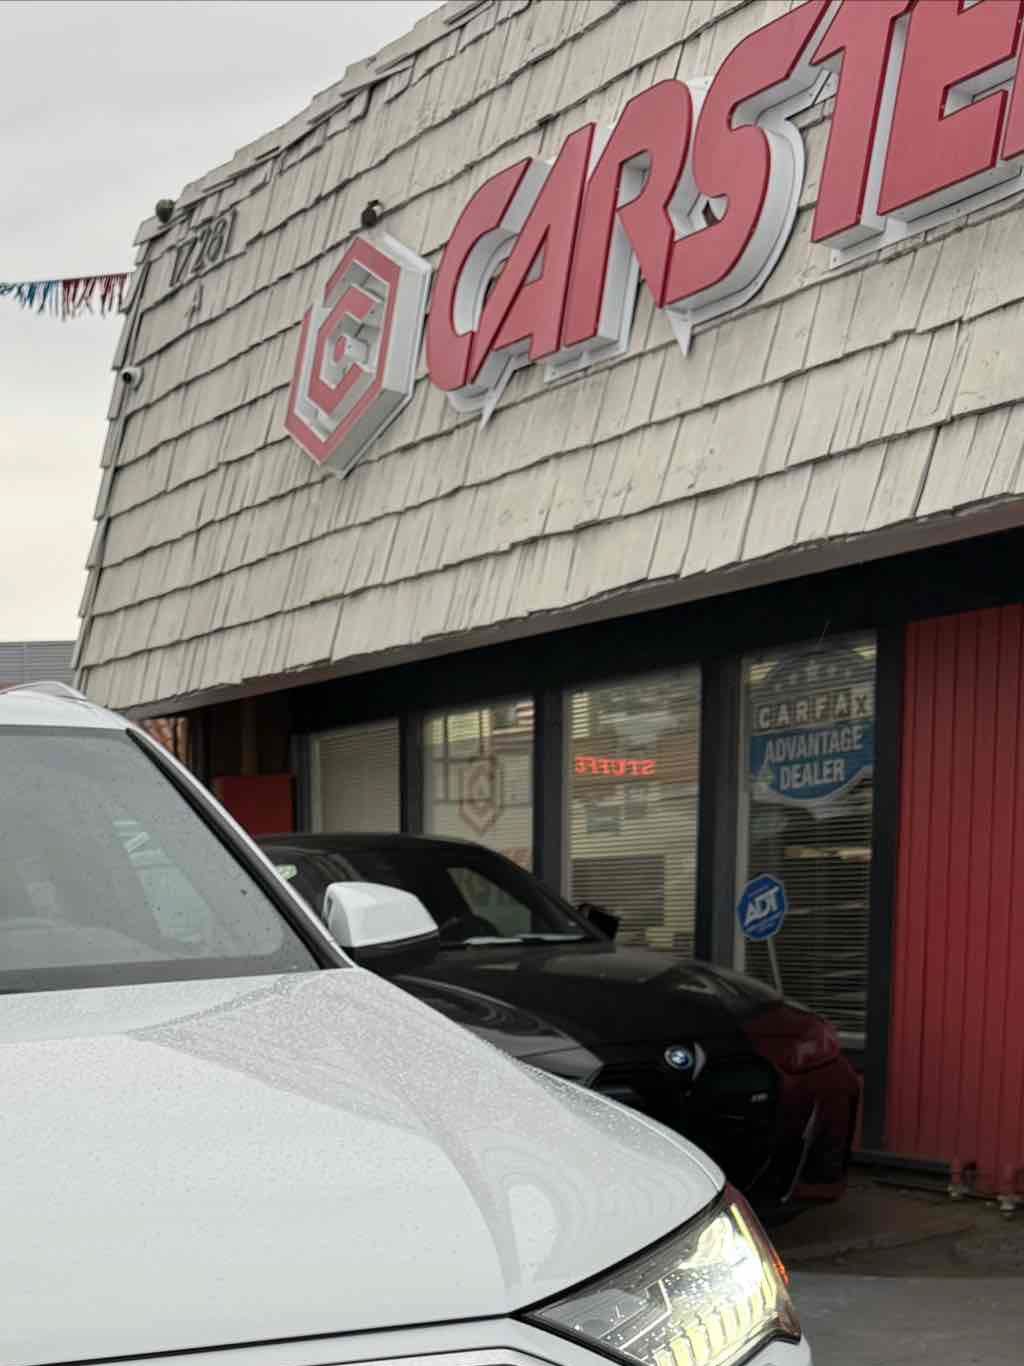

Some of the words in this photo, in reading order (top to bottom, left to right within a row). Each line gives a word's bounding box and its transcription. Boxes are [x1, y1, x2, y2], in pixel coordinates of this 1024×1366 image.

[425, 0, 1024, 391] CARSTE
[758, 692, 869, 728] CARFAX
[764, 725, 864, 764] ADVANTAGE
[779, 758, 845, 790] DEALER
[744, 885, 780, 927] ADT
